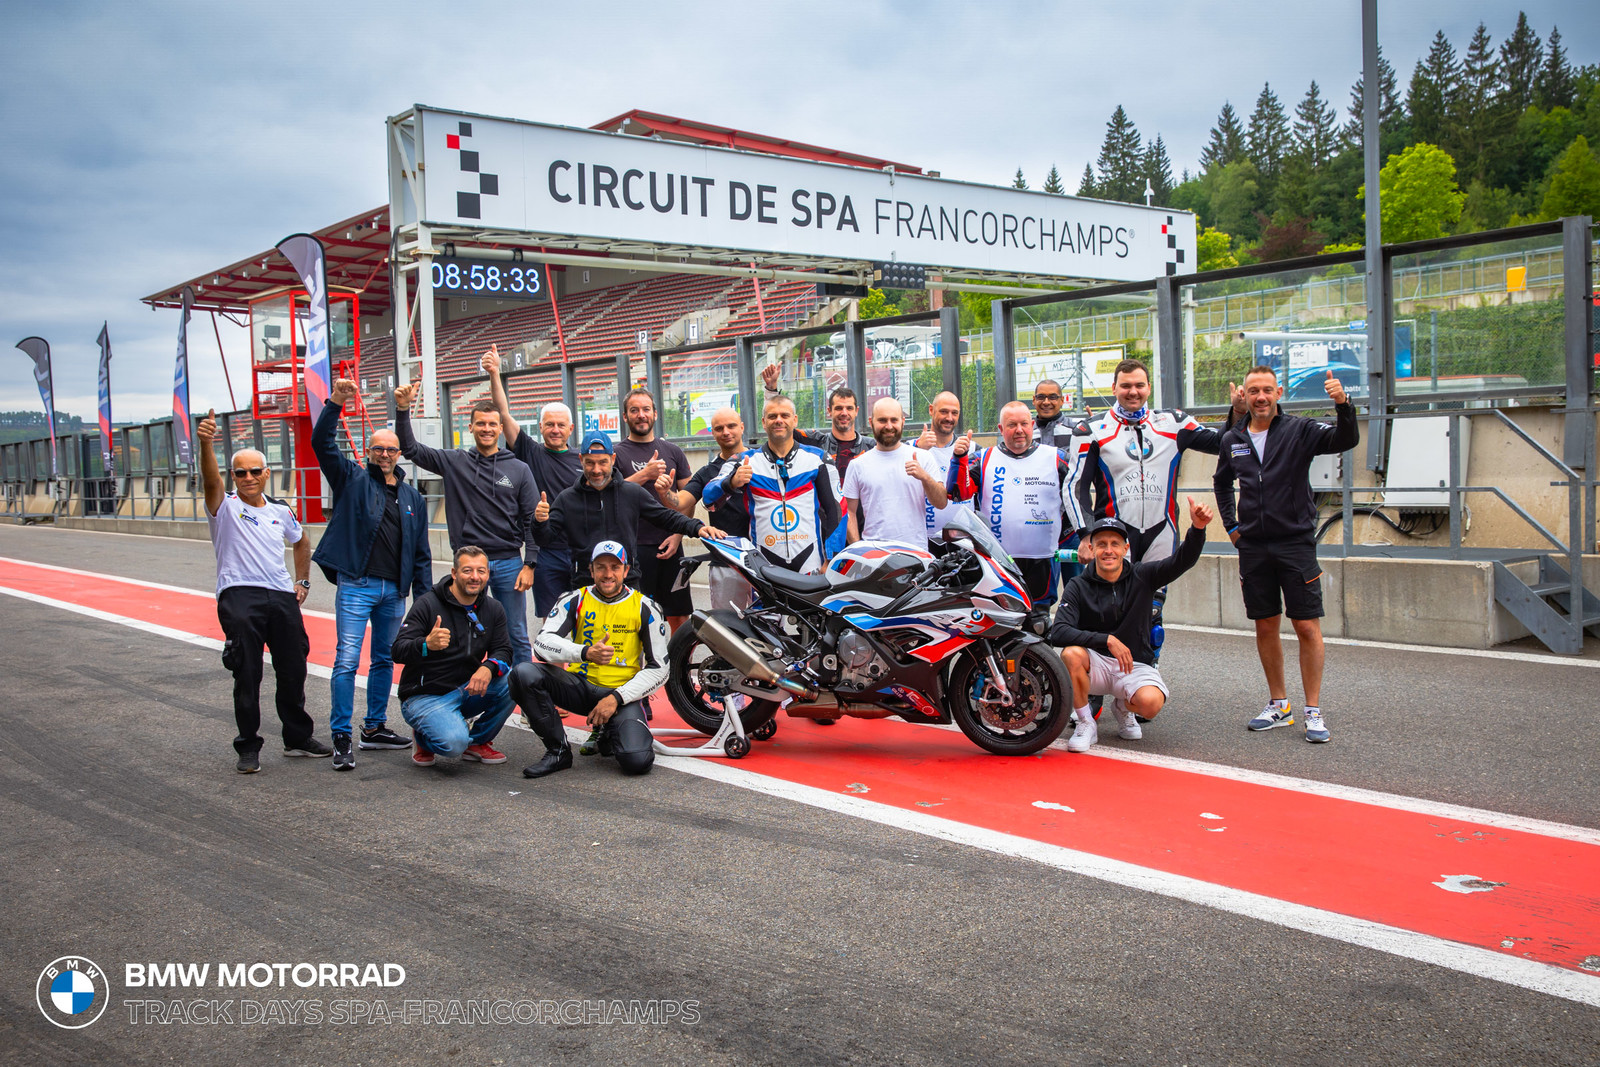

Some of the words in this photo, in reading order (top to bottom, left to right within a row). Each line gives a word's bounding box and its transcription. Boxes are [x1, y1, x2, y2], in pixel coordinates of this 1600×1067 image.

[548, 160, 715, 217] CIRCUIT
[729, 181, 778, 224] DE
[791, 189, 860, 233] SPA
[431, 262, 541, 294] 08:58:33
[640, 332, 647, 343] P
[585, 414, 619, 430] BigMat
[925, 498, 936, 530] TRAC
[775, 533, 809, 541] Location
[539, 643, 562, 654] Motorrad
